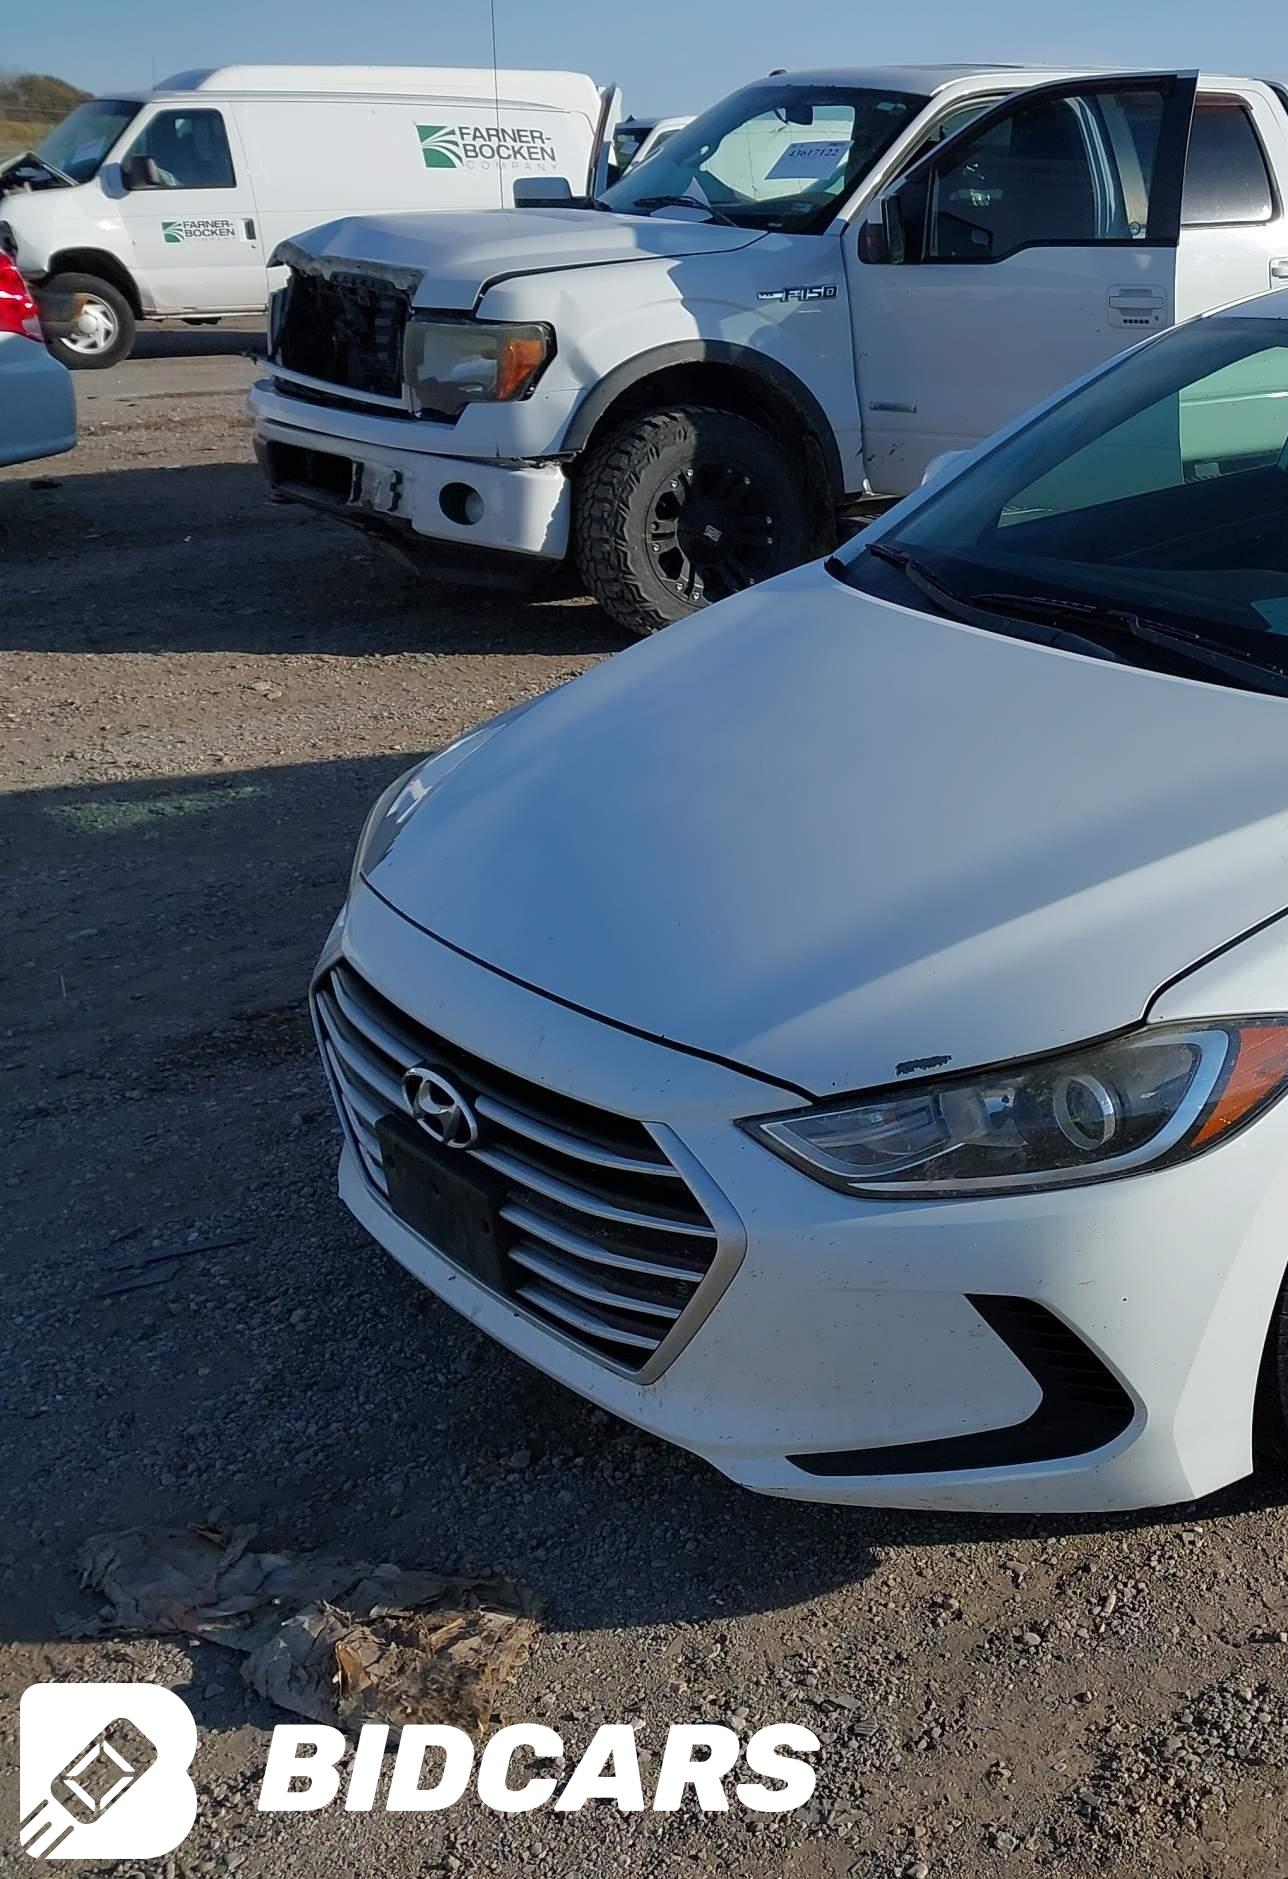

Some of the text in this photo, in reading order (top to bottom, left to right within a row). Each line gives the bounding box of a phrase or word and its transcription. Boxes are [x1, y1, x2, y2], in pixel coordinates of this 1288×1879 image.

[458, 126, 552, 144] FARNER-
[463, 143, 557, 162] BOCKEN
[465, 159, 558, 172] COMPANY
[183, 219, 234, 229] FARNER-
[184, 228, 236, 238] BOCKEN
